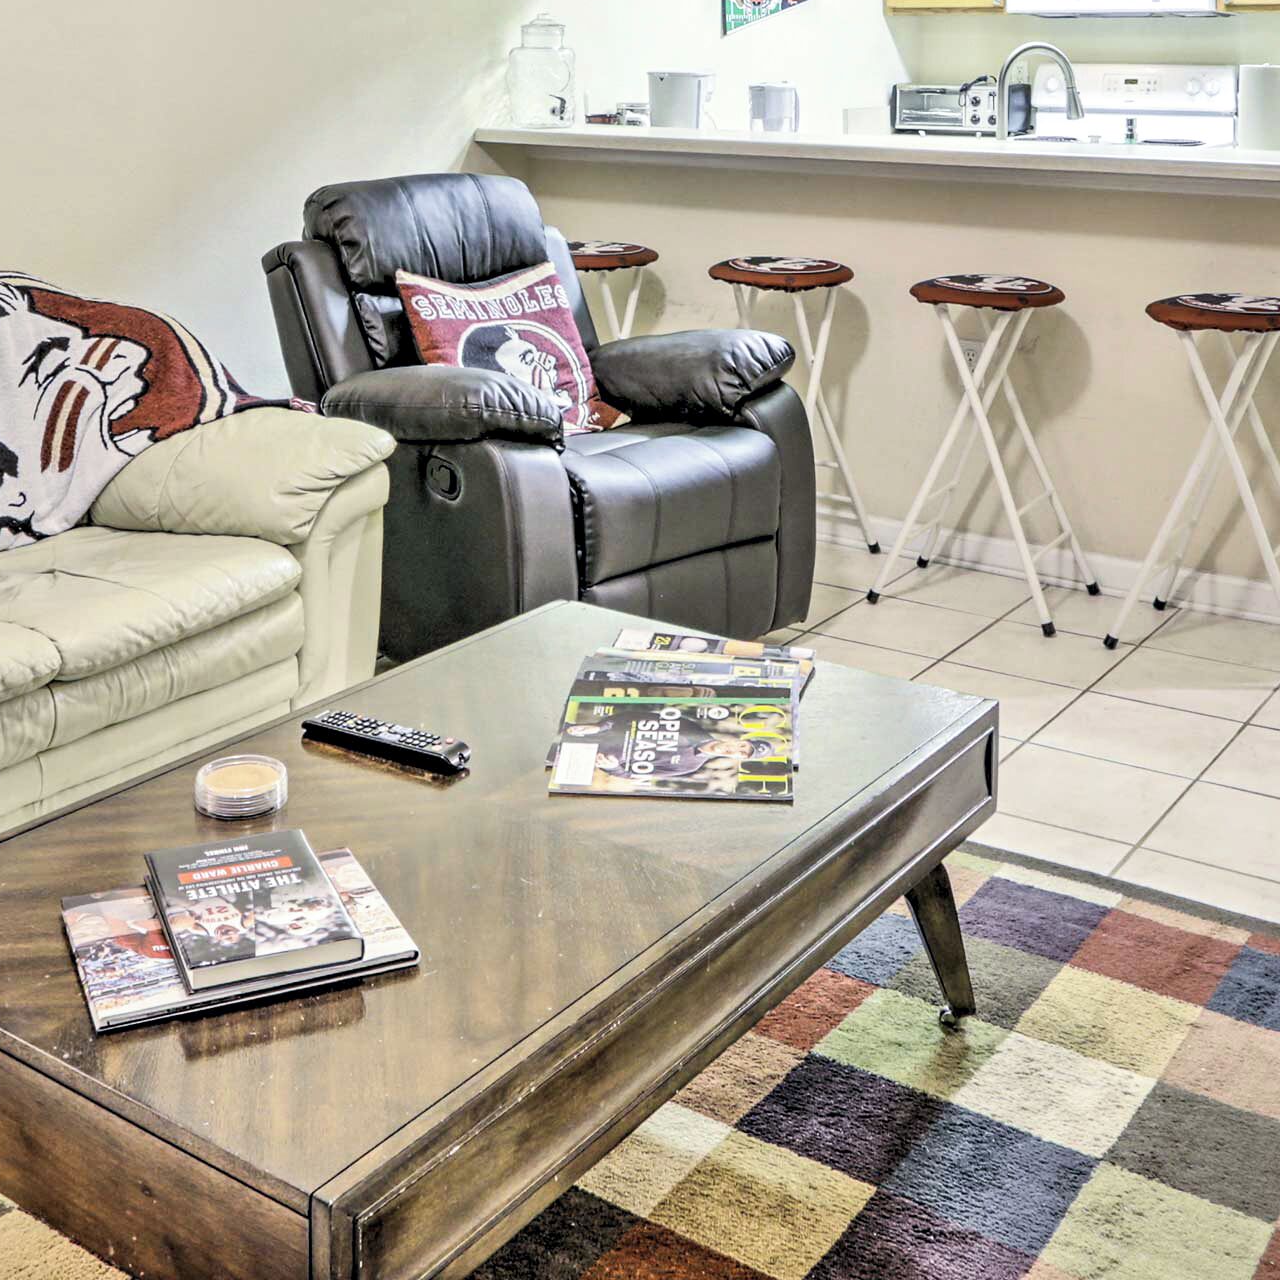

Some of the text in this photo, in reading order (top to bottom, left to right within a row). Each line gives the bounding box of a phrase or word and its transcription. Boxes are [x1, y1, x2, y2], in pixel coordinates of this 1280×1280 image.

[411, 284, 570, 321] SEMINOLES
[657, 706, 682, 753] OPEN
[630, 719, 659, 787] SEASON
[192, 867, 228, 880] WARD
[230, 859, 279, 875] CHARLIE
[185, 871, 302, 902] THE ATHLETE
